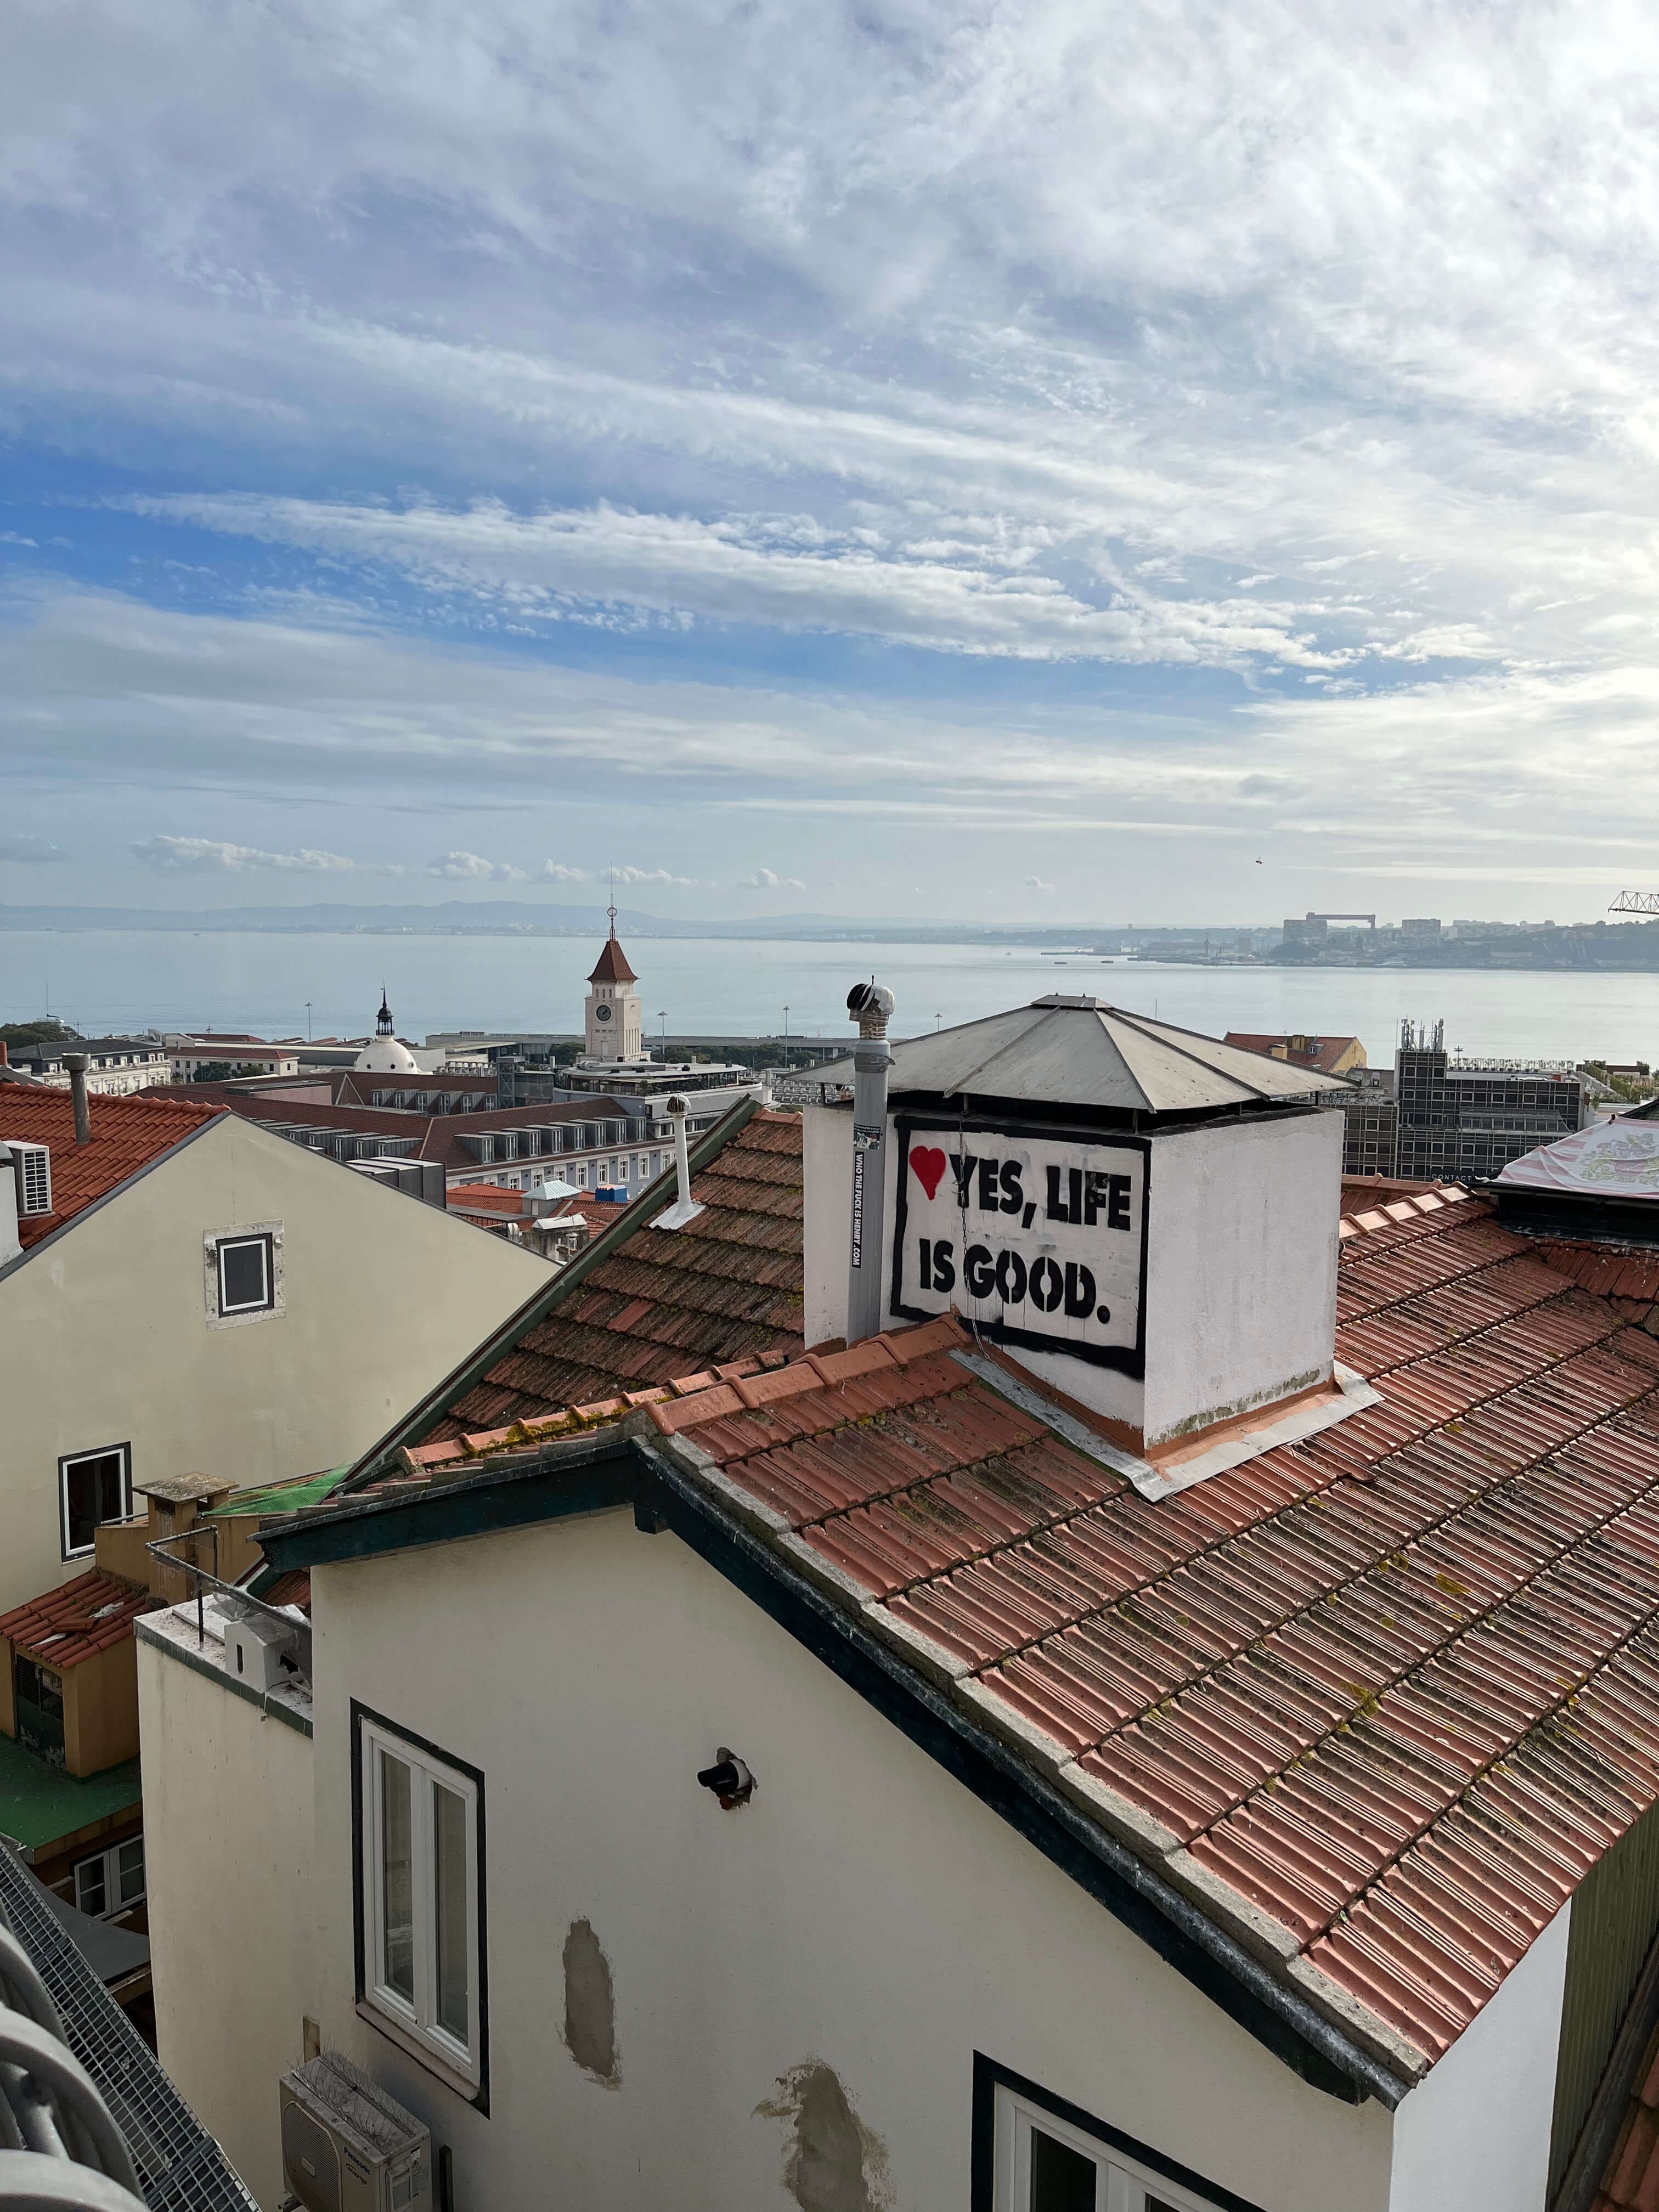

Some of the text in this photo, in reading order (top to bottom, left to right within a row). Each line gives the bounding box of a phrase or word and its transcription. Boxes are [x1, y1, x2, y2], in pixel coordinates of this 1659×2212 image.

[854, 1189, 862, 1210] FUCK
[949, 1154, 1131, 1231] YES, LIFE
[918, 1238, 1110, 1324] IS GOOD.
[344, 2146, 370, 2175] Panasonic
